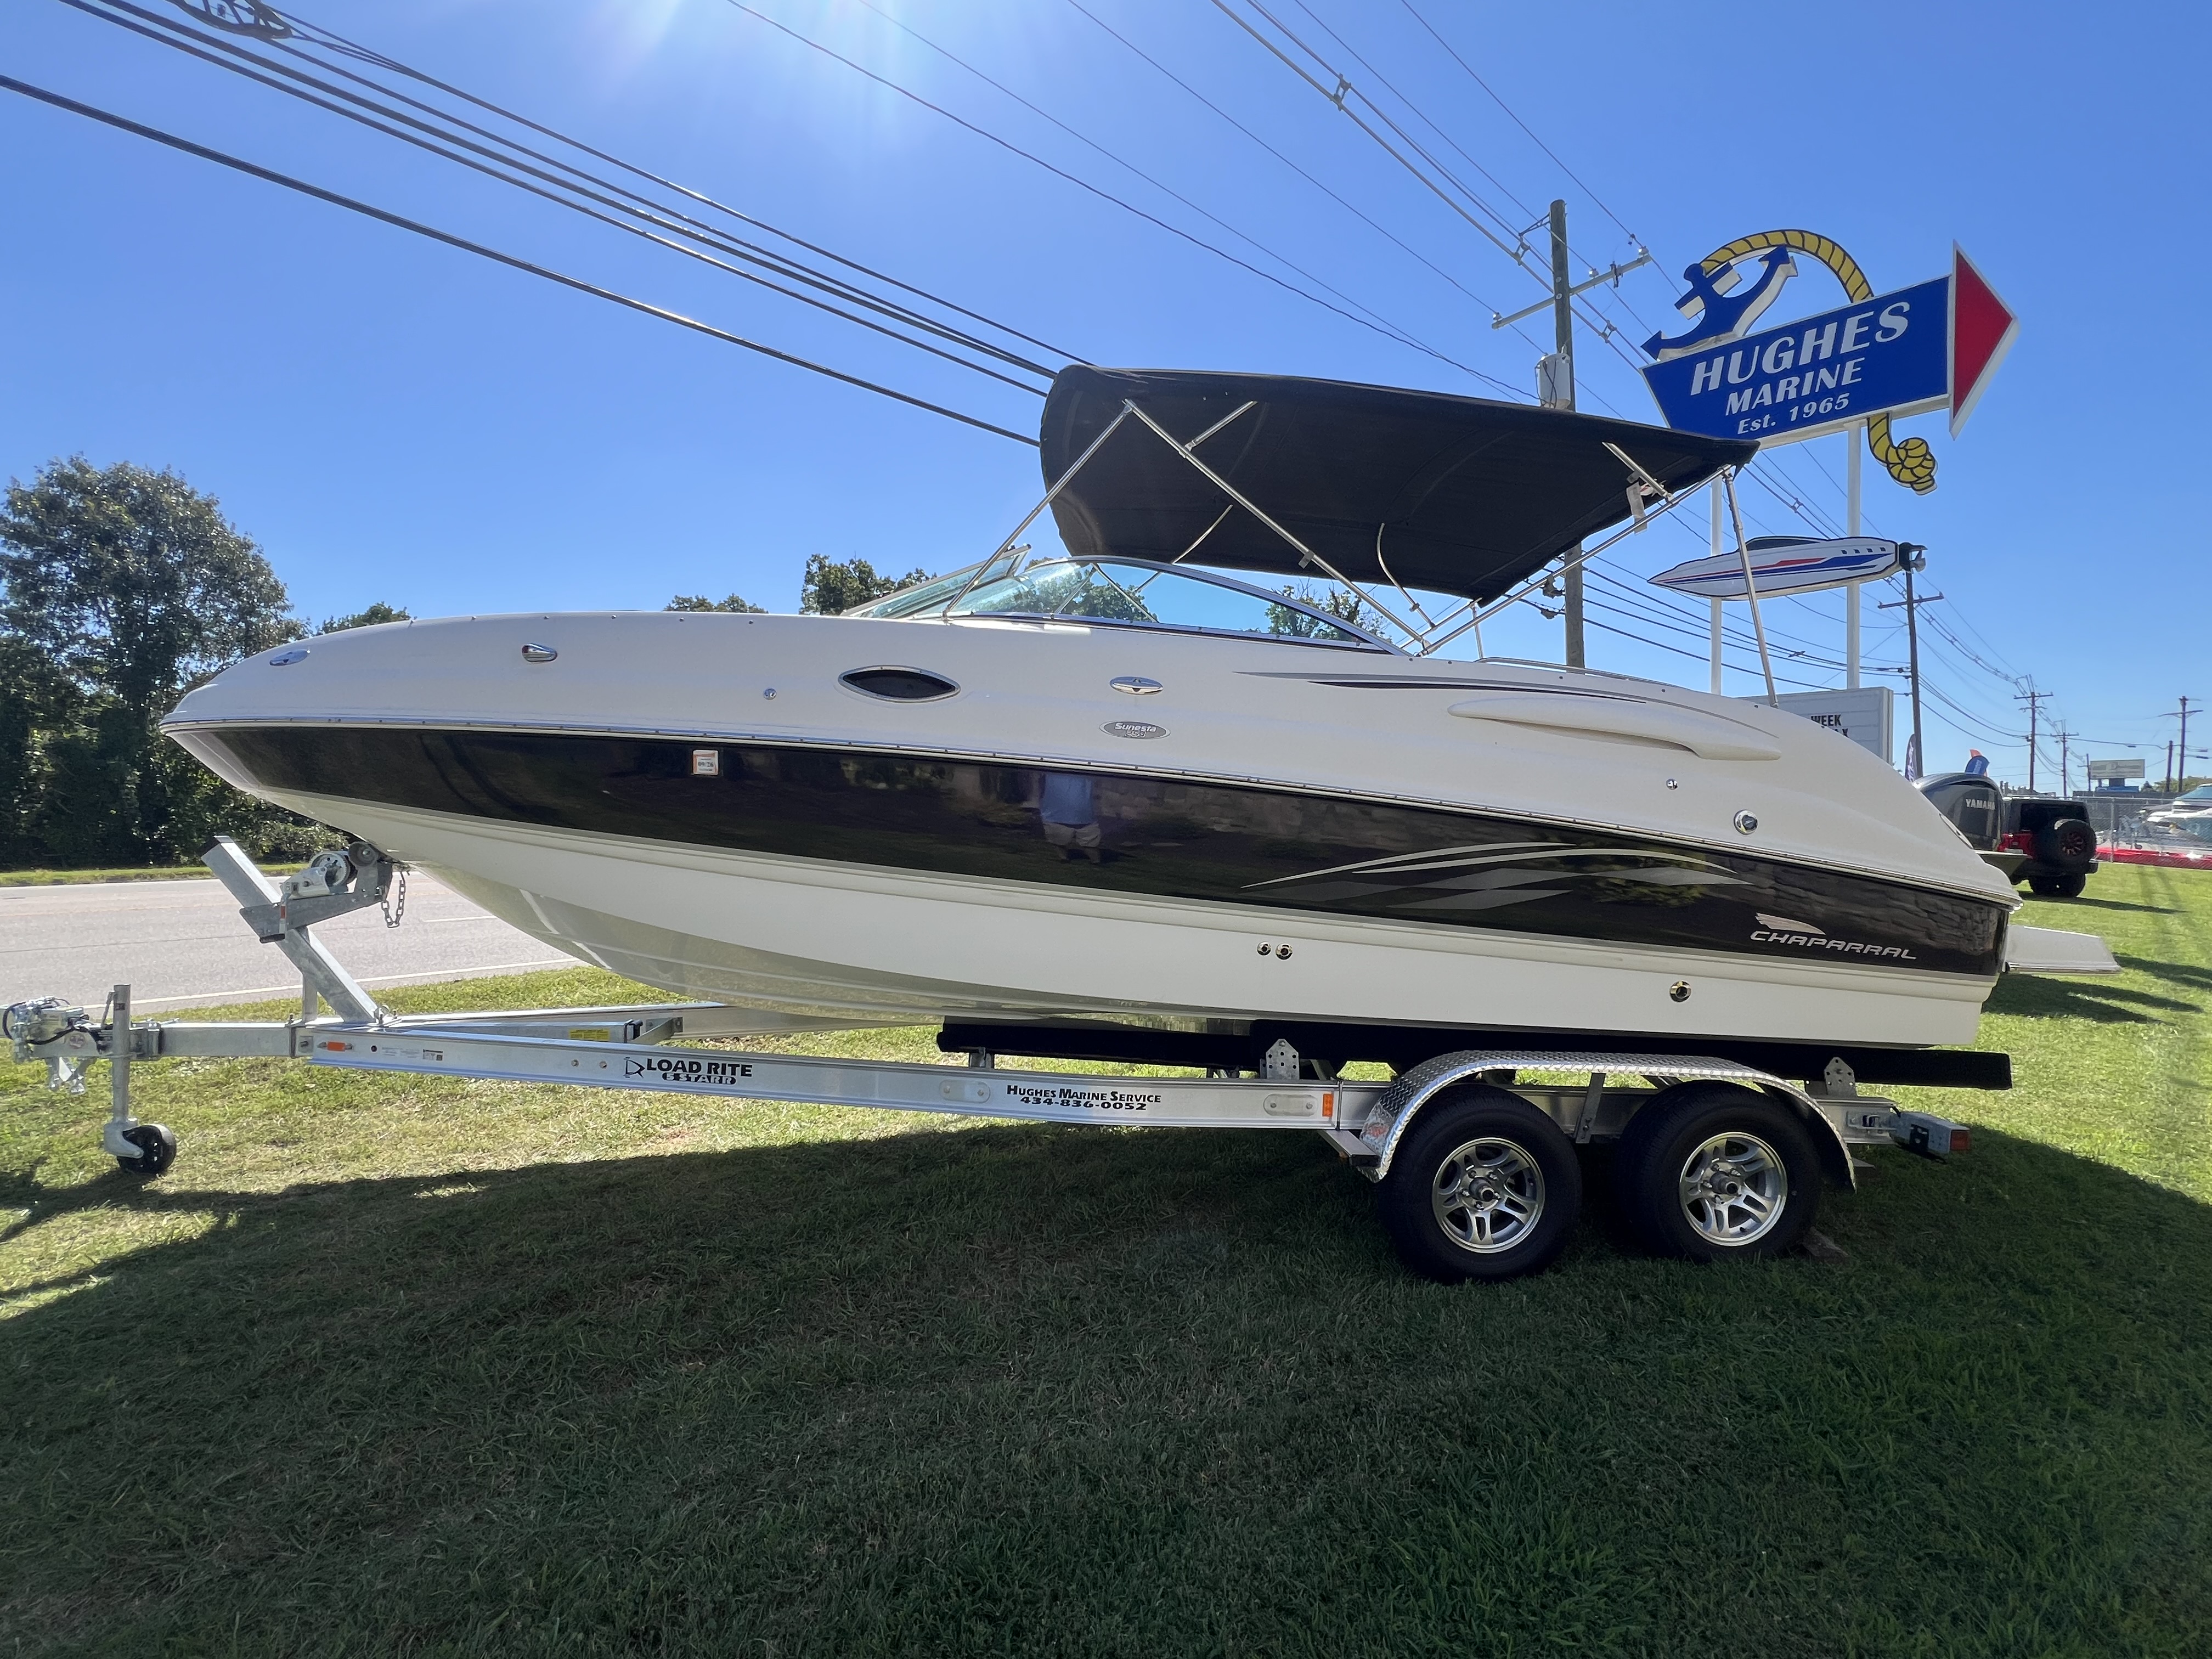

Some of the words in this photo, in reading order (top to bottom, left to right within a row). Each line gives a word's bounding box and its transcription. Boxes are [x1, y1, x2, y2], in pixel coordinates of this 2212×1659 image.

[1690, 302, 1910, 396] HUGHES
[1725, 357, 1865, 416] MARINE
[1737, 414, 1776, 435] Est.
[1789, 393, 1850, 422] 1965
[1114, 723, 1157, 732] Sunesta
[1810, 714, 1842, 727] WEEK
[1965, 798, 1995, 811] YAMAHA
[1750, 930, 1917, 960] CHAPARRAL
[647, 1058, 702, 1074] LOAD
[707, 1062, 753, 1077] RITE
[666, 1073, 675, 1081] 5
[679, 1074, 732, 1085] STARR
[1007, 1085, 1057, 1098] HUGHES
[1059, 1088, 1107, 1101] MARINE
[1109, 1091, 1161, 1103] SERVICE
[1020, 1097, 1147, 1110] 434-836-0052
